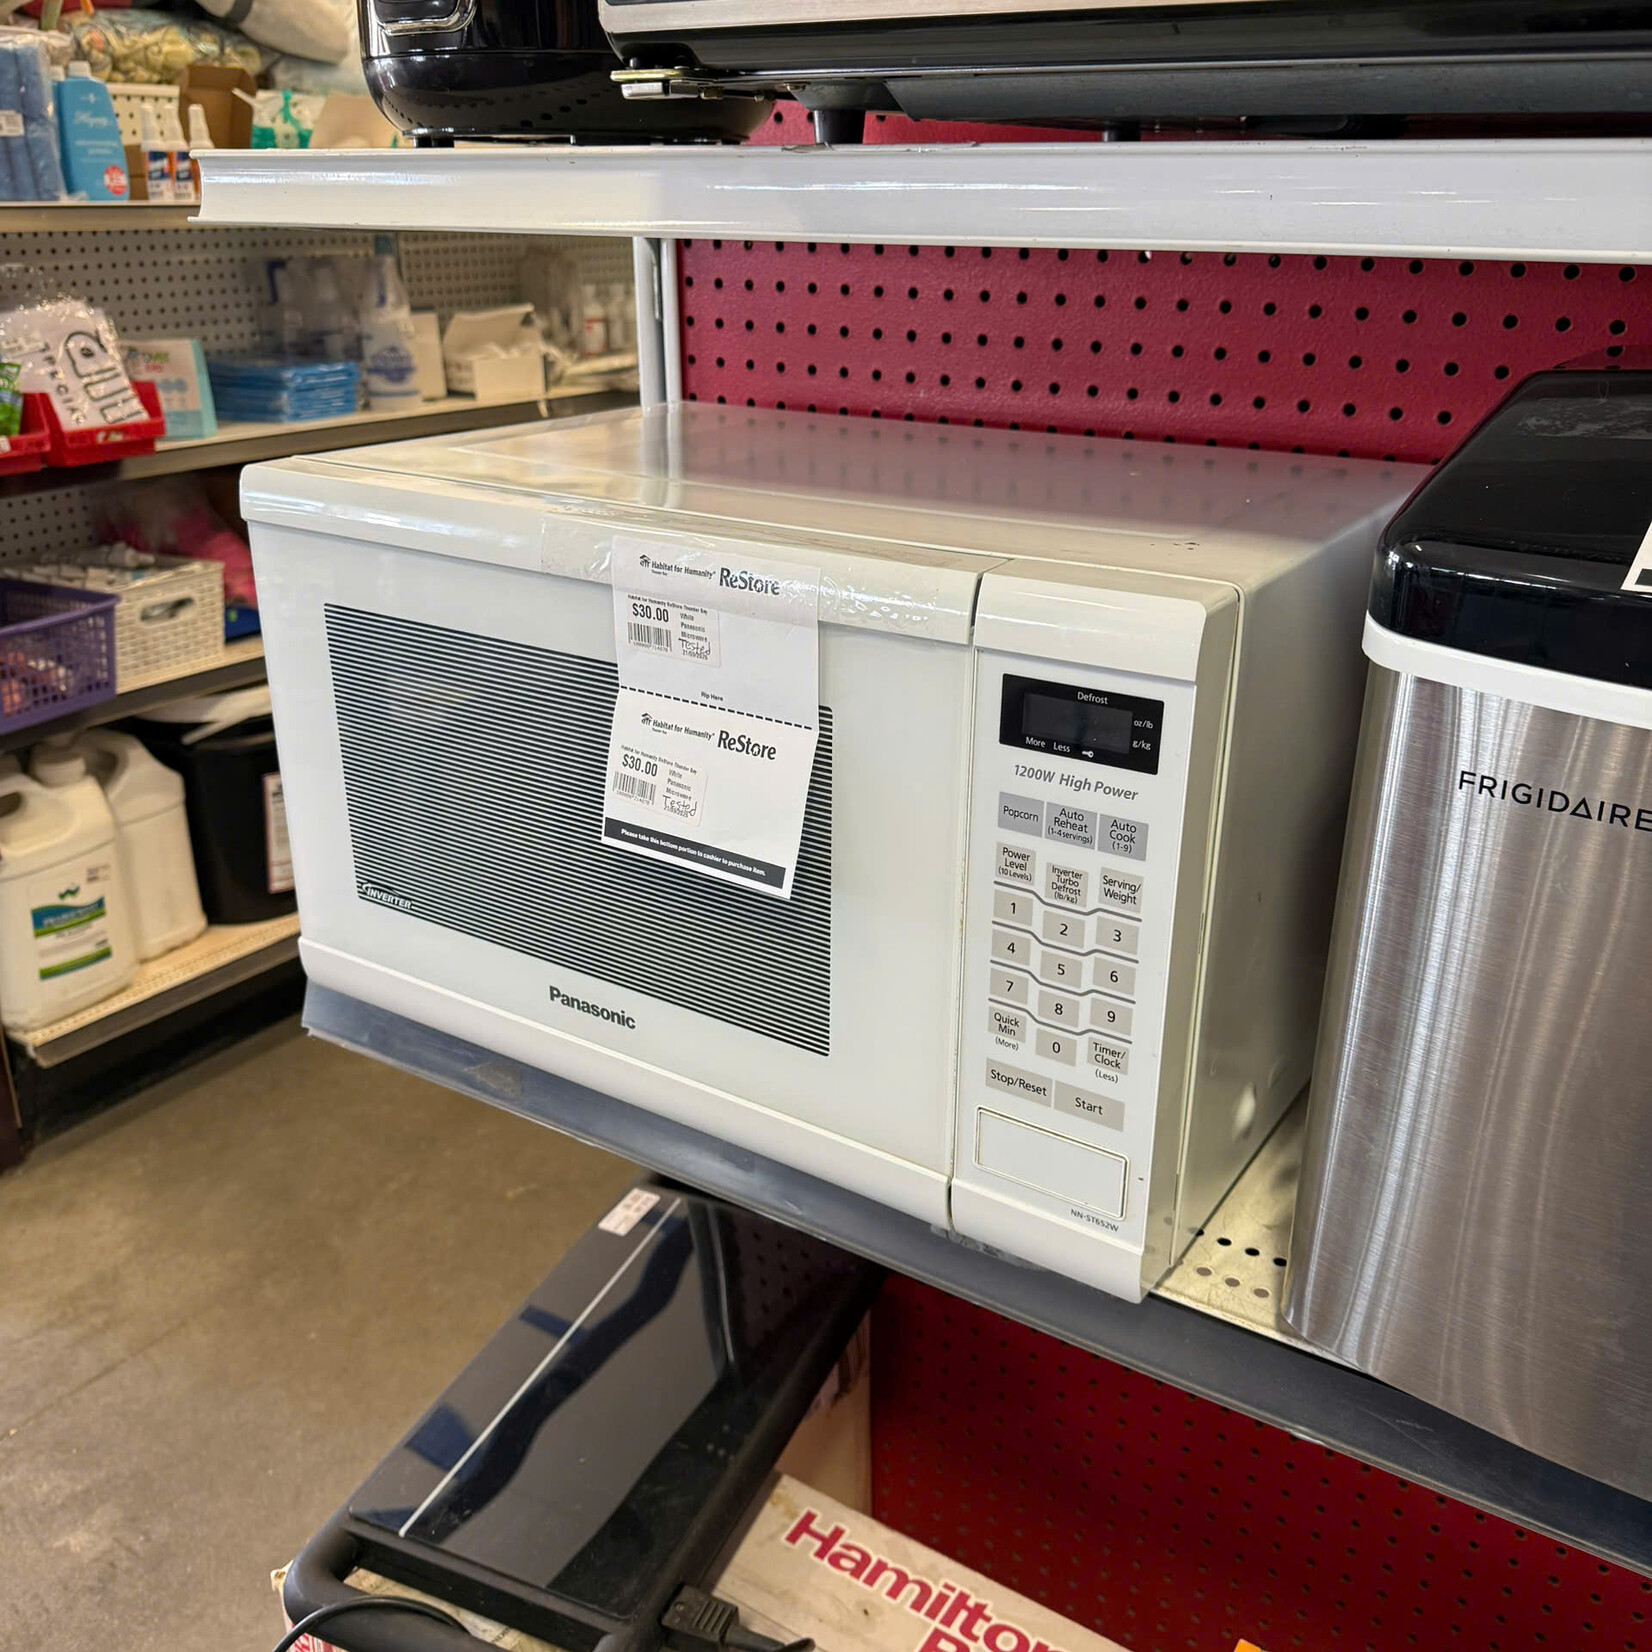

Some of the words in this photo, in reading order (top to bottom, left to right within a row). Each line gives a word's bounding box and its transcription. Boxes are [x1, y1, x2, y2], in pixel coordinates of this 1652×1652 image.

[652, 561, 673, 572] Habitat
[674, 565, 683, 574] for
[719, 567, 780, 596] ReStore
[632, 602, 669, 623] $30.00
[680, 612, 695, 621] White
[681, 622, 705, 633] Panasonic
[678, 638, 711, 656] Tested
[701, 691, 710, 700] Rip
[711, 693, 724, 701] Here
[1077, 692, 1108, 705] Defrost
[1133, 719, 1154, 730] oz/lb
[652, 719, 674, 731] Habitat
[674, 723, 683, 733] for
[718, 730, 777, 760] ReStore
[1025, 736, 1046, 748] More
[1053, 742, 1071, 753] Less
[1132, 740, 1152, 751] g/kg
[622, 753, 658, 777] $30.00
[668, 769, 683, 779] White
[667, 778, 692, 792] Panasonic
[1014, 764, 1056, 783] 1200W
[1059, 773, 1092, 792] High
[1094, 781, 1139, 801] Power
[662, 794, 698, 817] Tested
[1459, 770, 1652, 832] FRIGIDAIRE
[1003, 805, 1039, 822] Popcorn
[1060, 808, 1085, 822] Auto
[1053, 816, 1088, 834] Reheat
[1110, 819, 1137, 834] Auto
[1109, 829, 1136, 844] Cook
[621, 828, 638, 839] Please
[638, 833, 650, 842] take
[650, 836, 659, 845] this
[660, 839, 678, 850] bottom
[678, 845, 697, 856] portion
[703, 852, 722, 863] cashier
[728, 860, 752, 872] purchase
[1002, 846, 1030, 862] Power
[1112, 841, 1132, 854] (1-9)
[1004, 858, 1027, 871] Level
[998, 866, 1009, 876] (10
[1009, 869, 1032, 882] Levels)
[1052, 865, 1083, 880] Inverter
[1056, 874, 1080, 887] Turbo
[1103, 875, 1141, 892] Serving/
[1051, 881, 1081, 896] Defrost
[1103, 887, 1137, 905] Weight
[367, 888, 412, 910] INVERTER
[1054, 890, 1078, 905] (lb/kg)
[1010, 902, 1016, 914] 1
[1059, 923, 1068, 936] 2
[1112, 929, 1122, 942] 3
[1006, 942, 1016, 954] 4
[1057, 963, 1066, 976] 5
[1109, 970, 1119, 983] 6
[1005, 979, 1014, 992] 7
[549, 985, 636, 1030] Panasonic
[1054, 1002, 1063, 1016] 8
[993, 1012, 1020, 1028] Quick
[1107, 1010, 1116, 1023] 9
[998, 1023, 1016, 1037] Min
[995, 1036, 1019, 1051] (More)
[1052, 1041, 1061, 1054] 0
[1093, 1042, 1127, 1059] Timer/
[1094, 1053, 1121, 1070] Clock
[990, 1069, 1047, 1097] Stop/Reset
[1095, 1068, 1119, 1084] (Less)
[1075, 1097, 1103, 1116] Start
[1071, 1208, 1119, 1232] NN-ST652W
[784, 1509, 1067, 1652] Hamilto
